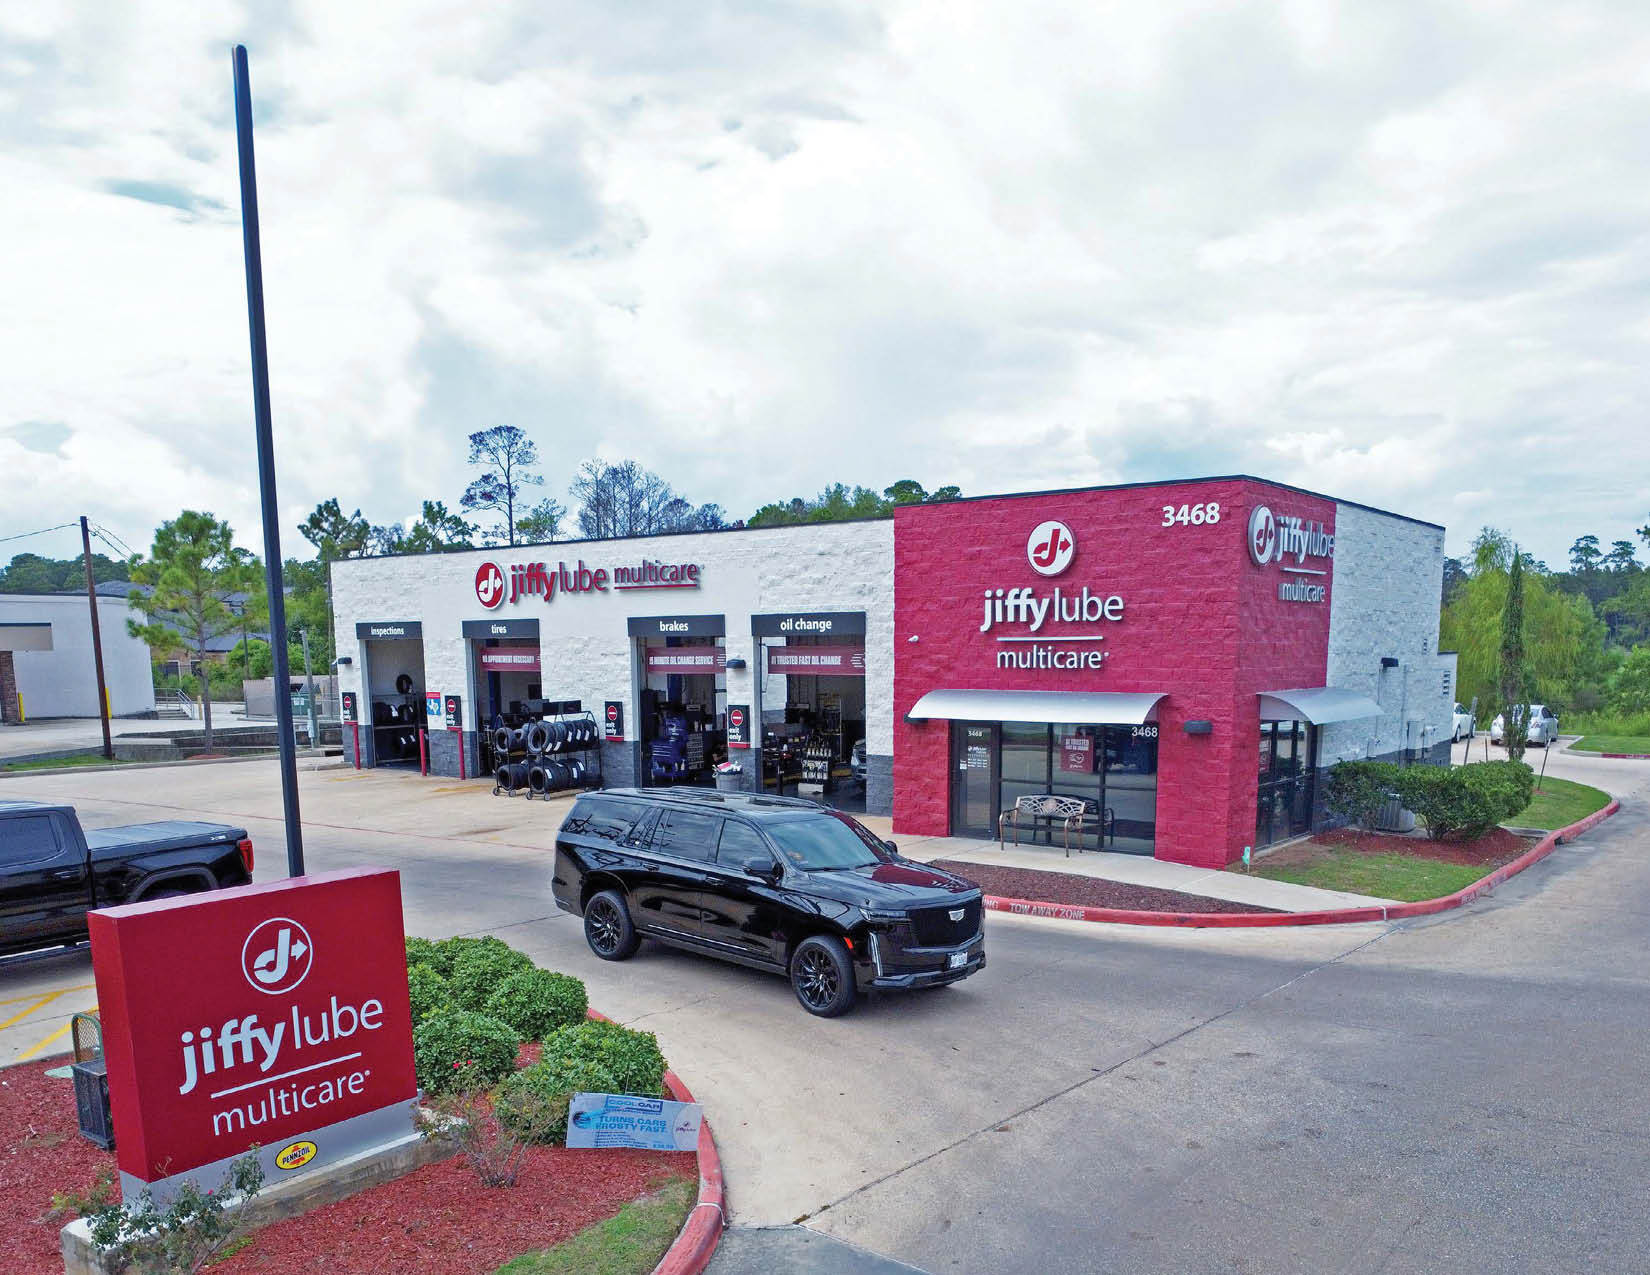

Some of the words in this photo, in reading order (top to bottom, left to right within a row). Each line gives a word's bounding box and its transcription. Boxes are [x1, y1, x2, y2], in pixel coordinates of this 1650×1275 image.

[1161, 502, 1221, 527] 3468
[614, 560, 700, 584] multicare
[1280, 577, 1326, 603] multicare
[370, 626, 404, 638] inspections
[491, 624, 507, 634] tires
[659, 621, 689, 632] brakes
[780, 619, 793, 631] oil
[795, 618, 832, 633] change
[996, 644, 1102, 669] multicare
[1131, 726, 1158, 737] 3468
[1009, 903, 1030, 914] TOW
[1031, 905, 1058, 918] AWAY
[1060, 908, 1085, 920] ZONE
[212, 1071, 365, 1136] multicare
[595, 1121, 638, 1131] FROSTY
[599, 1115, 635, 1124] TURNS
[637, 1117, 668, 1127] CARS
[281, 1146, 312, 1166] PENNZOIL
